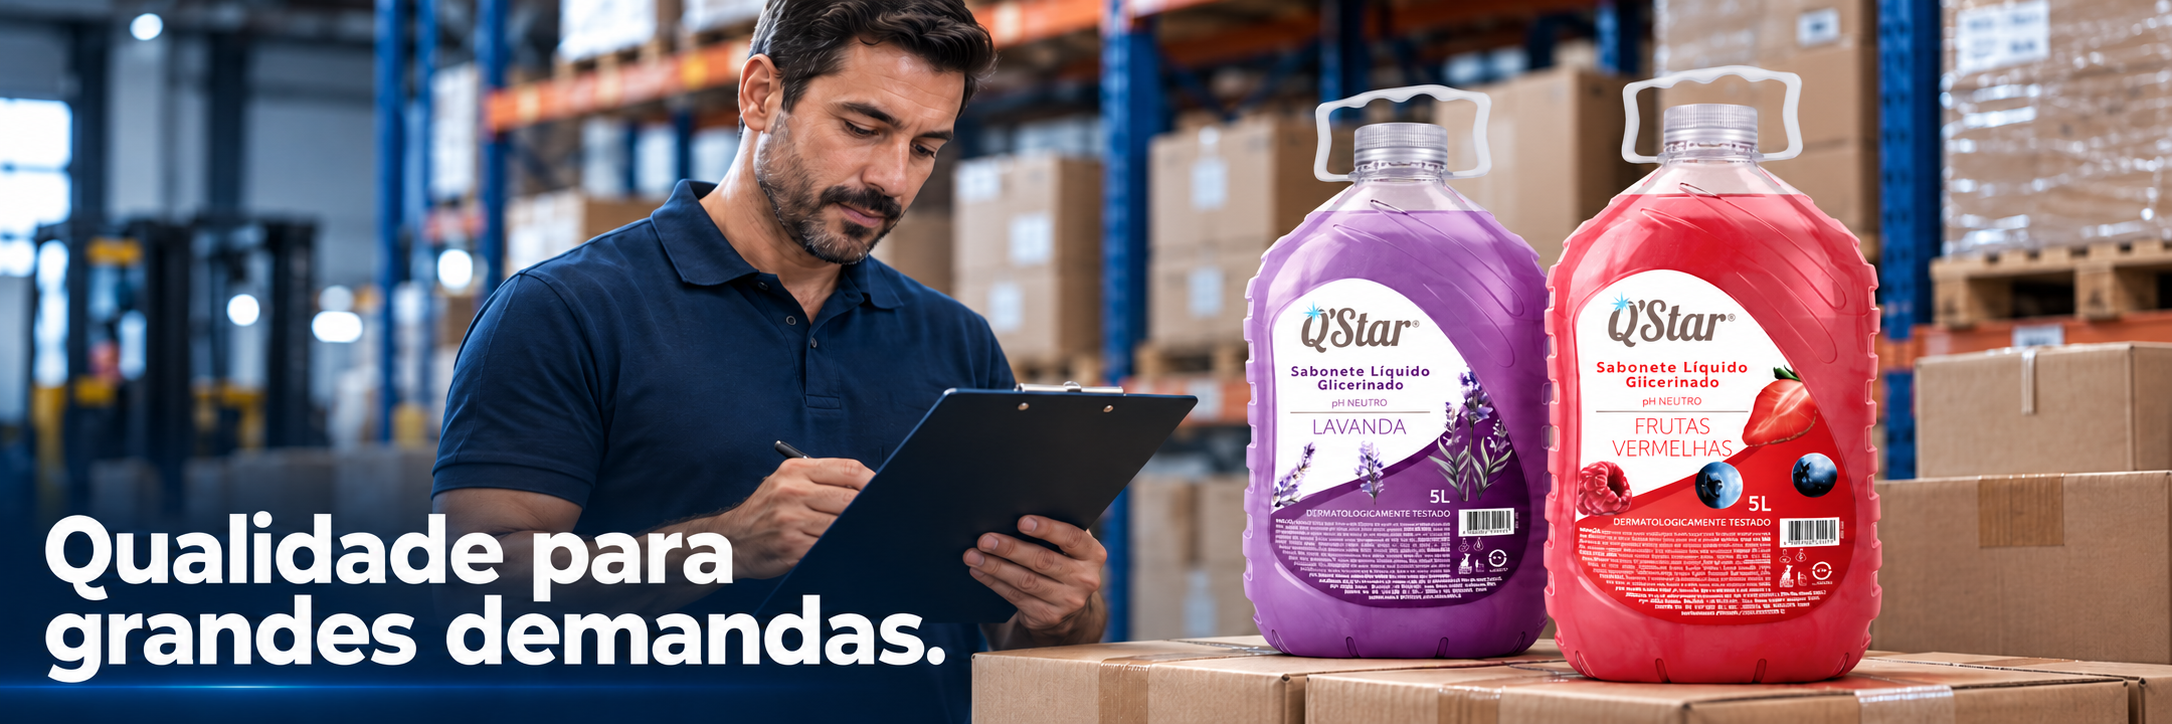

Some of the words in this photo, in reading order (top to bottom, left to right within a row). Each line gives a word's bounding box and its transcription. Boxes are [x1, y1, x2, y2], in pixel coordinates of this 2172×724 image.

[1291, 365, 1364, 377] Sabonete
[1371, 365, 1430, 379] Líquido
[1597, 361, 1677, 373] Sabonete
[1684, 361, 1748, 376] Líquido
[1317, 379, 1404, 390] Glicerinado
[1331, 399, 1345, 409] pH
[1347, 398, 1388, 407] NEUTRO
[1642, 397, 1656, 407] pH
[1659, 397, 1702, 405] NEUTRO
[1313, 418, 1407, 435] LAVANDA
[1635, 418, 1711, 435] FRUTAS
[1612, 440, 1732, 457] VERMELHAS
[1430, 489, 1451, 504] 5L
[1748, 495, 1772, 512] 5L
[1412, 509, 1451, 518] TESTADO
[1613, 517, 1727, 527] DERMATOLOGICAMENTE
[1731, 518, 1771, 527] TESTADO
